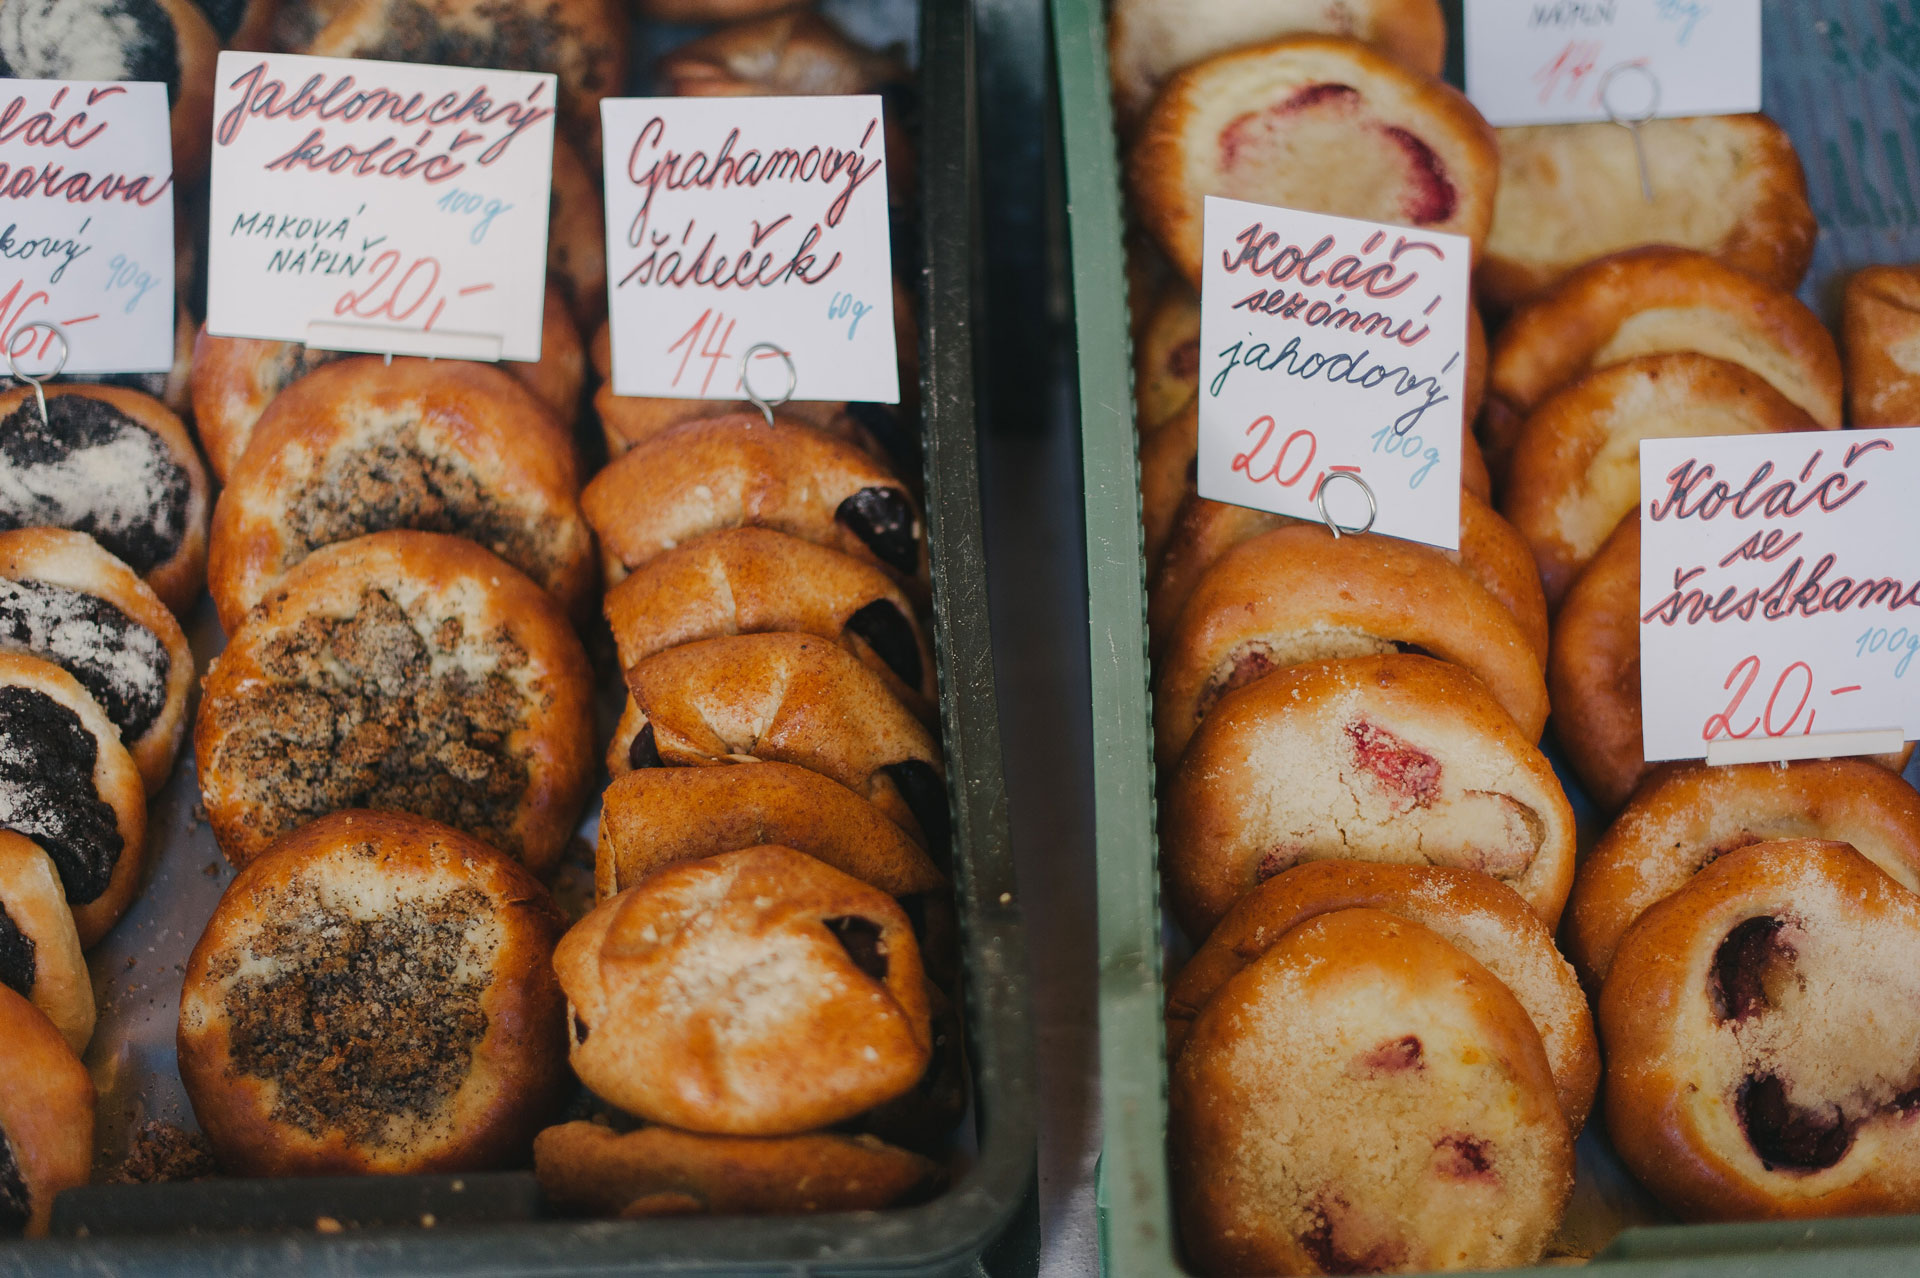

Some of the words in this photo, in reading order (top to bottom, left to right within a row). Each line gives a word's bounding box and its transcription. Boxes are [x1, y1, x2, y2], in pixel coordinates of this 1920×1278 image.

[216, 61, 555, 166] Jablonecký
[264, 128, 485, 183] koláč
[628, 116, 882, 248] Grahamový
[230, 203, 367, 241] MAKOVÁ
[437, 188, 514, 245] 100g
[267, 236, 388, 277] NÁPLŇ
[617, 214, 842, 290] šáteček
[1222, 222, 1446, 299] Koláč
[105, 253, 160, 314] 90g
[827, 291, 873, 341] 60g
[1231, 290, 1442, 347] sezónní
[1210, 332, 1460, 437] jahodový
[1371, 425, 1440, 489] 100g
[1650, 439, 1894, 522] Koláč
[1719, 528, 1803, 568] se
[1856, 627, 1920, 680] 100g
